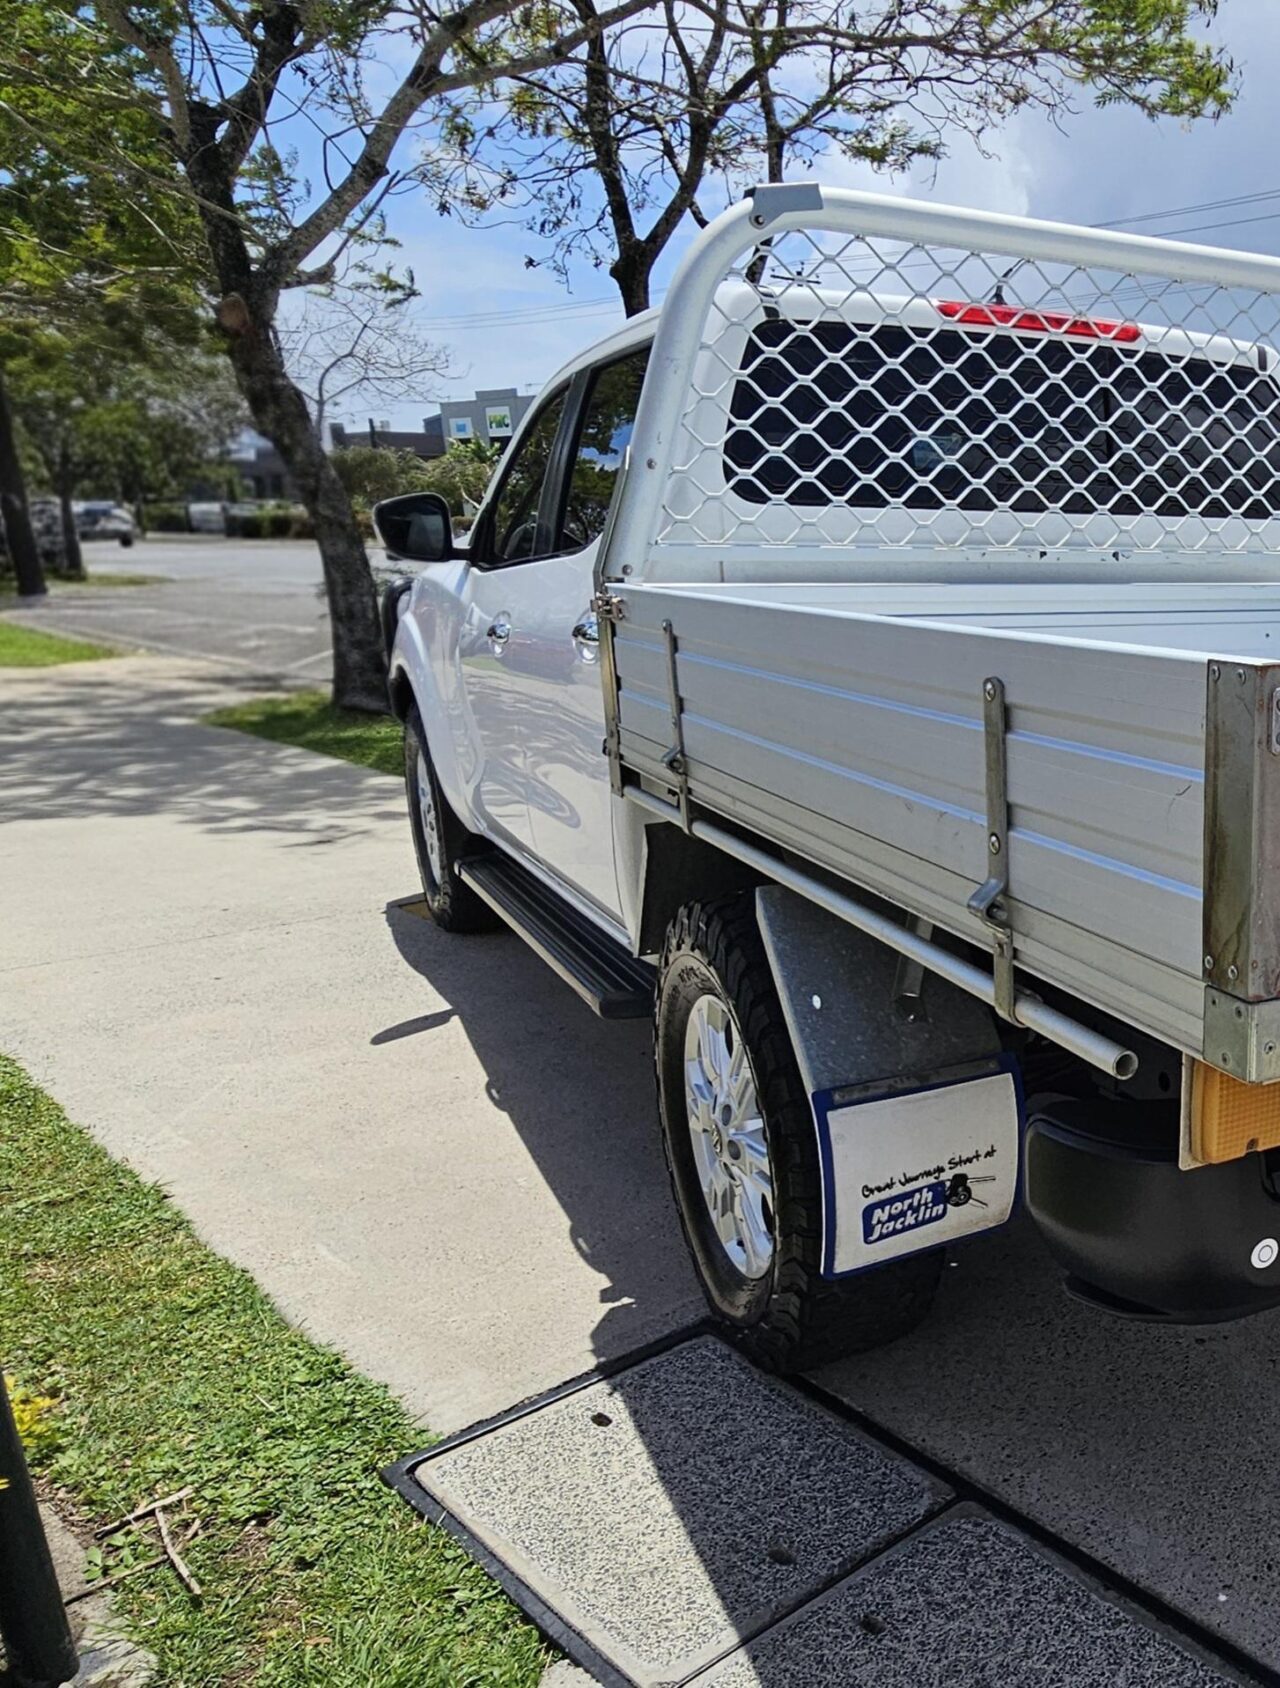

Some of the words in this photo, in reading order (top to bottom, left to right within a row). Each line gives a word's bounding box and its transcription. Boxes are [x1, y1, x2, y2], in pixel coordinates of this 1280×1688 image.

[861, 1176, 896, 1198] Great
[898, 1164, 946, 1187] Journeys
[947, 1149, 982, 1170] Start
[983, 1144, 997, 1159] at
[867, 1203, 944, 1241] Jacklin
[871, 1187, 933, 1225] North
